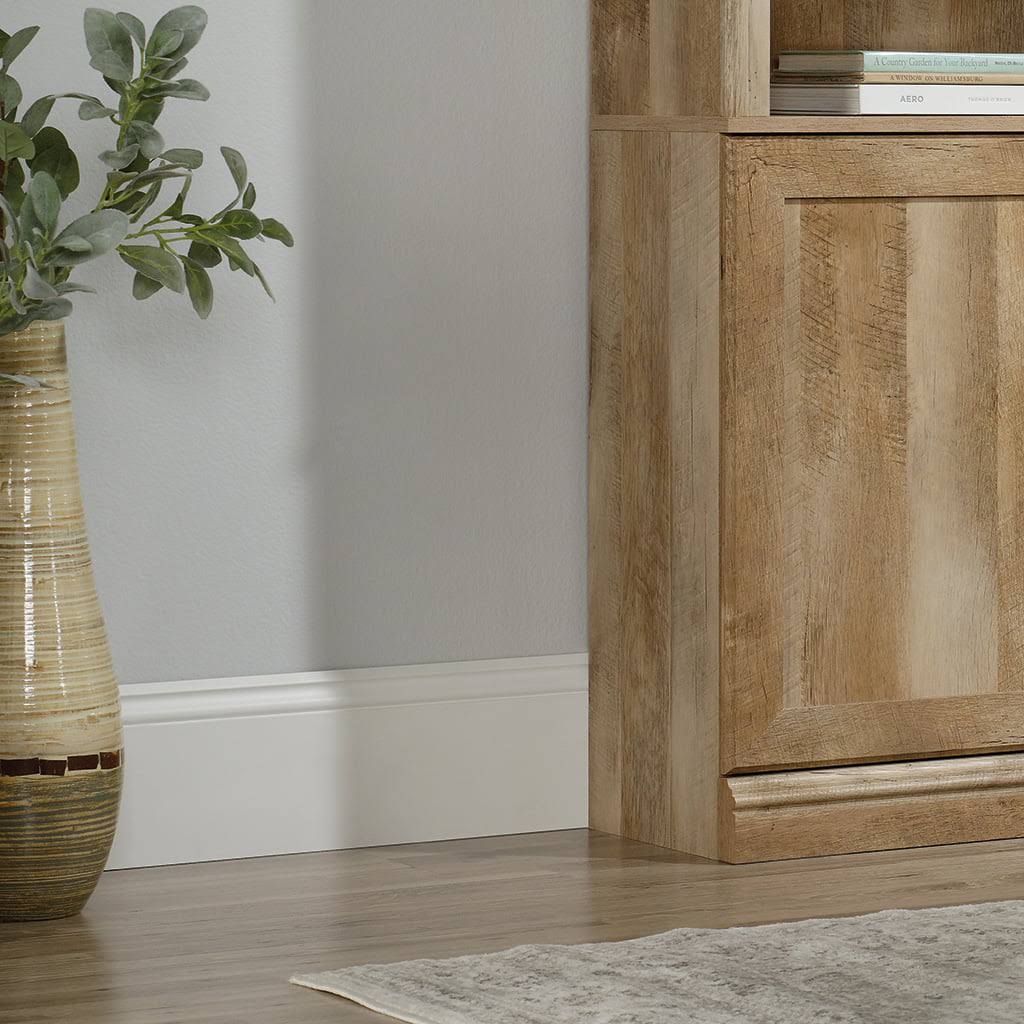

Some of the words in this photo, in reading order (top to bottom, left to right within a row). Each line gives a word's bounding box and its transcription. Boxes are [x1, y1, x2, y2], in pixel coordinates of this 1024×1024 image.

[873, 56, 880, 66] A
[881, 57, 907, 69] Country
[908, 57, 932, 66] Garden
[932, 57, 943, 66] for
[945, 57, 960, 66] Your
[960, 57, 989, 69] Backyard
[900, 95, 924, 103] AERO
